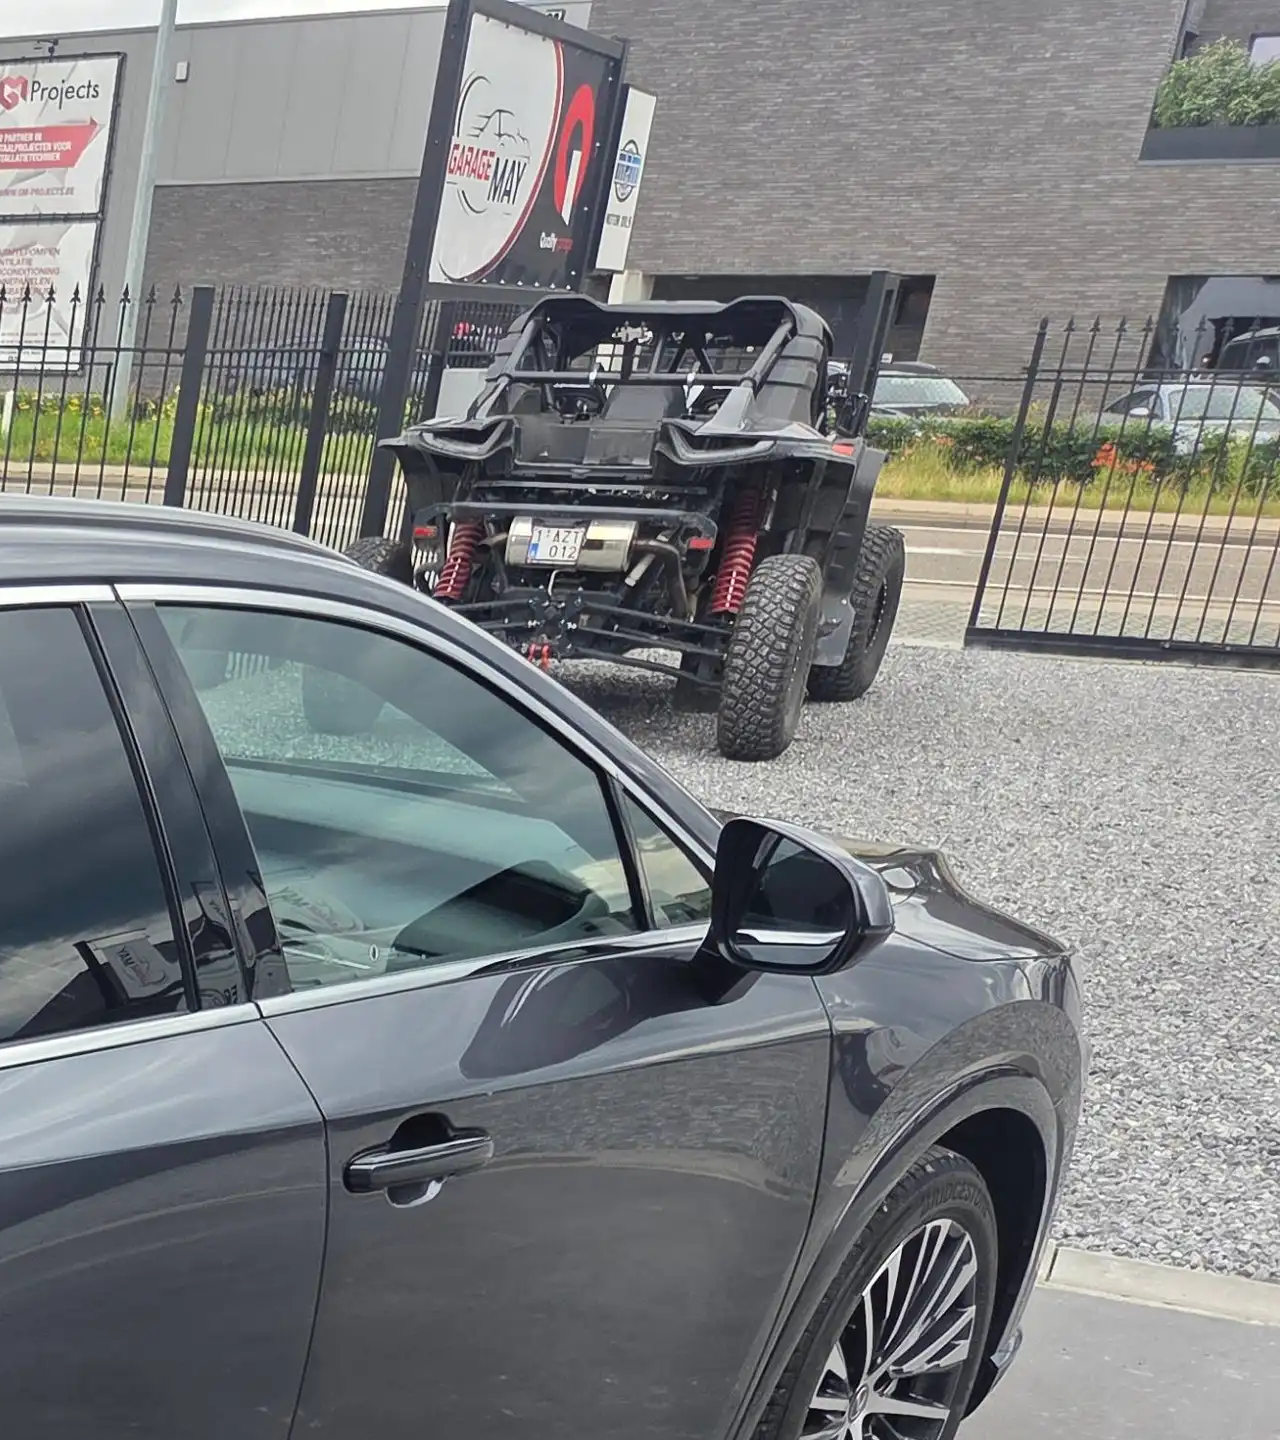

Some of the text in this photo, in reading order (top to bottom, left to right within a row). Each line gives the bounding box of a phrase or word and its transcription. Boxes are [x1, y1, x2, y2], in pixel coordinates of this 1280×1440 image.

[30, 79, 100, 110] Projects
[448, 143, 497, 181] GARAGE
[487, 156, 527, 206] MAY
[549, 545, 577, 559] 012
